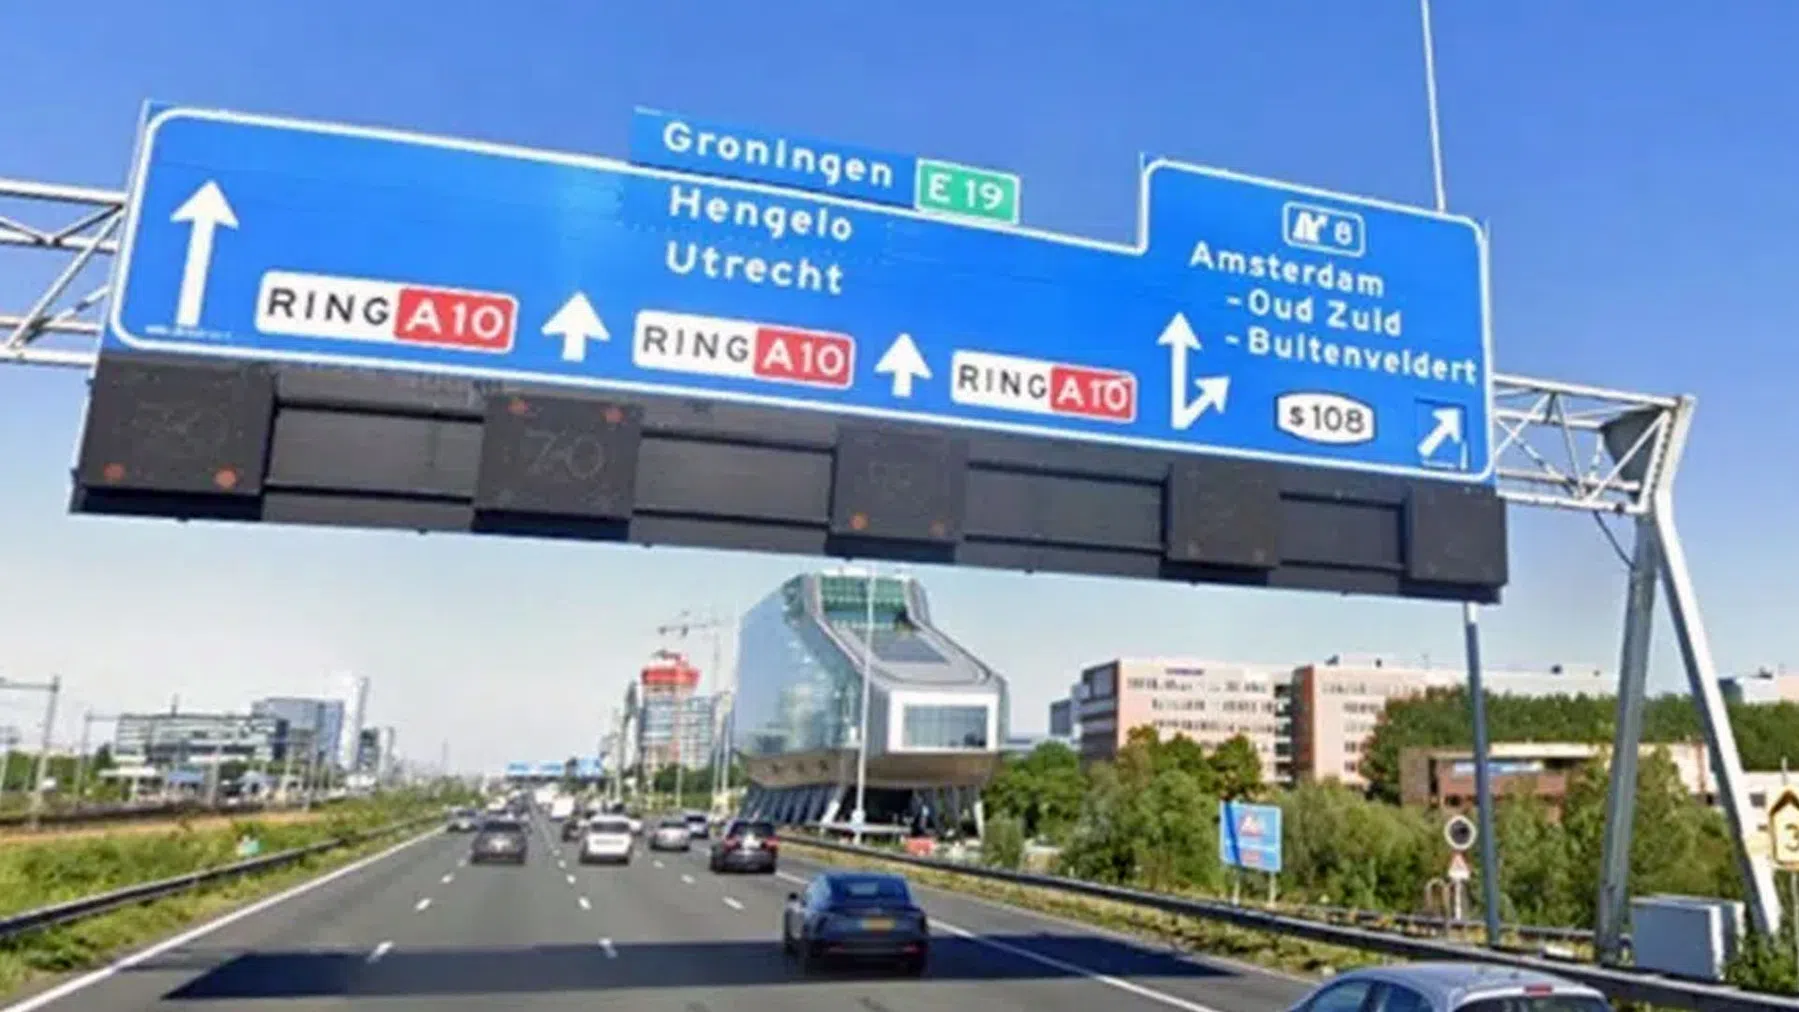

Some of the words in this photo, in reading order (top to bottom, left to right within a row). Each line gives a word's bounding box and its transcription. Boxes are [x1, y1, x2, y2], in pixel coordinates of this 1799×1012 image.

[663, 121, 892, 187] Groningen
[669, 185, 854, 242] Hengelo
[929, 172, 951, 201] E
[967, 180, 1004, 210] 19
[666, 240, 843, 295] Utrecht
[1189, 241, 1385, 298] Amsterdam
[266, 286, 391, 327] RING
[404, 299, 506, 341] A10
[642, 325, 750, 363] RING
[761, 337, 847, 378] A10
[957, 364, 1048, 400] RING
[1056, 376, 1129, 412] A10
